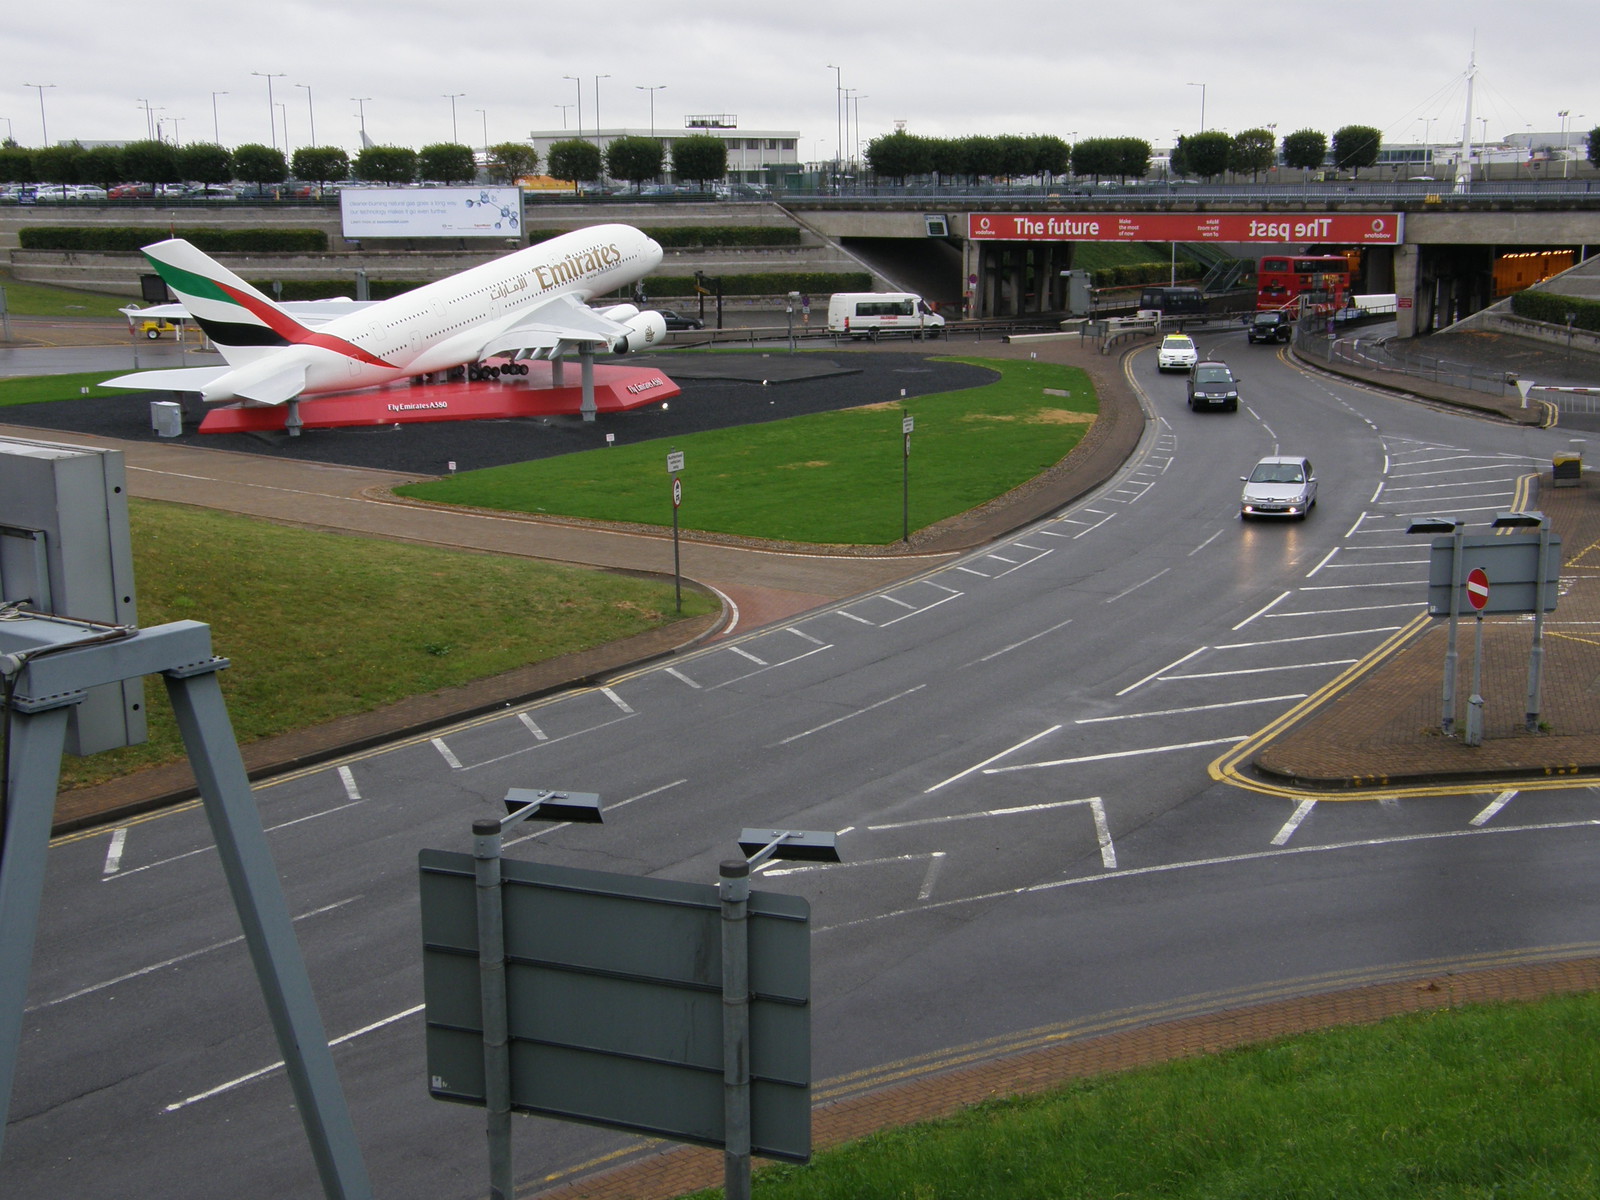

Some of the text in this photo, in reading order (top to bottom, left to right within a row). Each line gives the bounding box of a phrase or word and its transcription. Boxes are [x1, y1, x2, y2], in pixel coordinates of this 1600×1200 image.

[1014, 218, 1099, 235] The future
[532, 243, 621, 290] Emirates
[388, 404, 399, 412] Fly
[400, 402, 429, 410] Emirates
